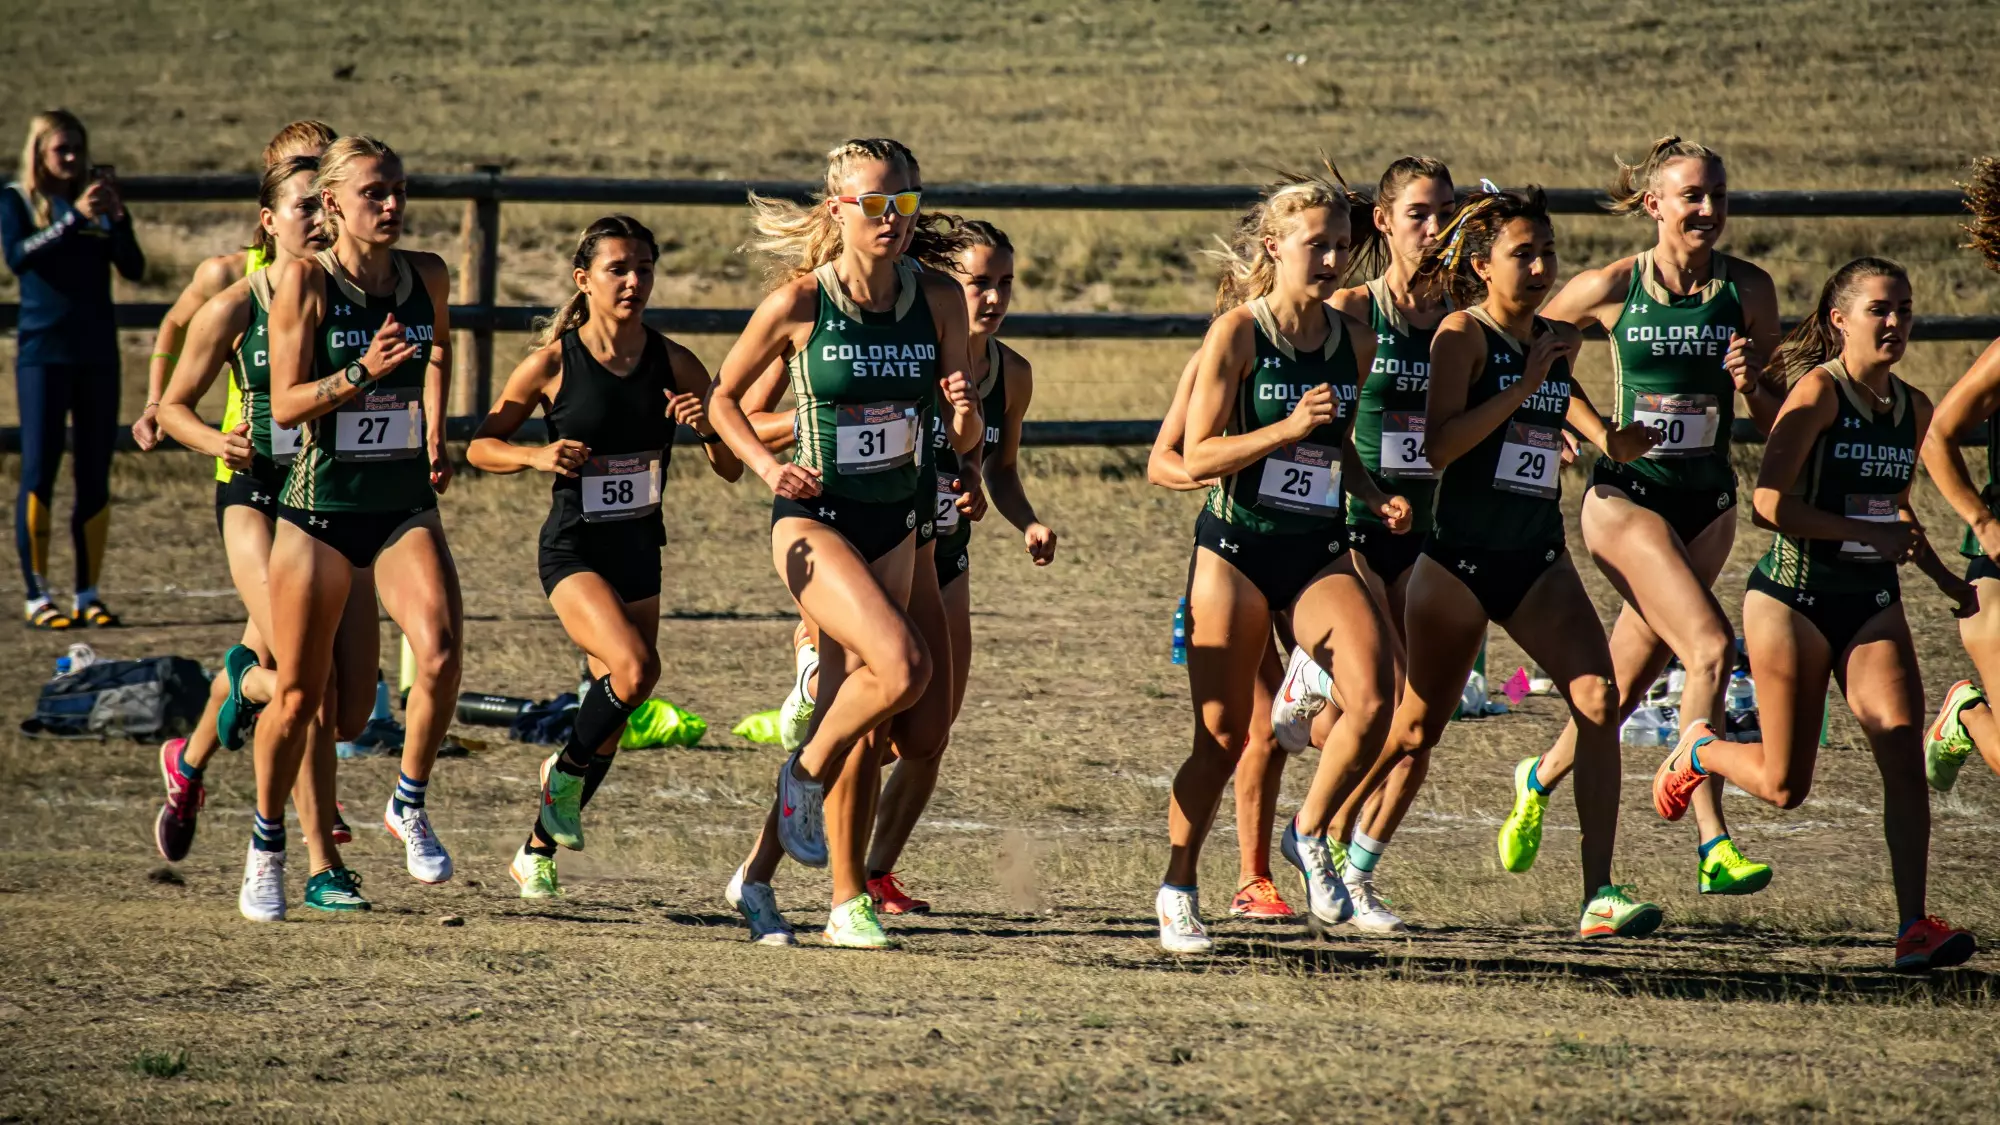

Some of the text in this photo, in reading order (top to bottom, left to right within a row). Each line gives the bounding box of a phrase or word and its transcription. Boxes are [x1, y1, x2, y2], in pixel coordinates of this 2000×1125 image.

[332, 325, 434, 348] COLADO
[822, 344, 936, 361] COLORADO
[1652, 341, 1718, 356] STATE
[852, 361, 921, 377] STATE
[1371, 357, 1430, 376] COLO
[1259, 384, 1357, 400] COLADO
[1396, 377, 1430, 392] STA
[1521, 394, 1563, 414] STATE
[358, 417, 389, 444] 27
[1653, 419, 1684, 444] 30
[859, 428, 885, 457] 31
[1516, 451, 1546, 480] 29
[1860, 462, 1910, 480] STATE
[602, 480, 634, 505] 58
[1281, 468, 1313, 497] 25
[937, 498, 956, 520] 2
[603, 677, 630, 712] ZENS
